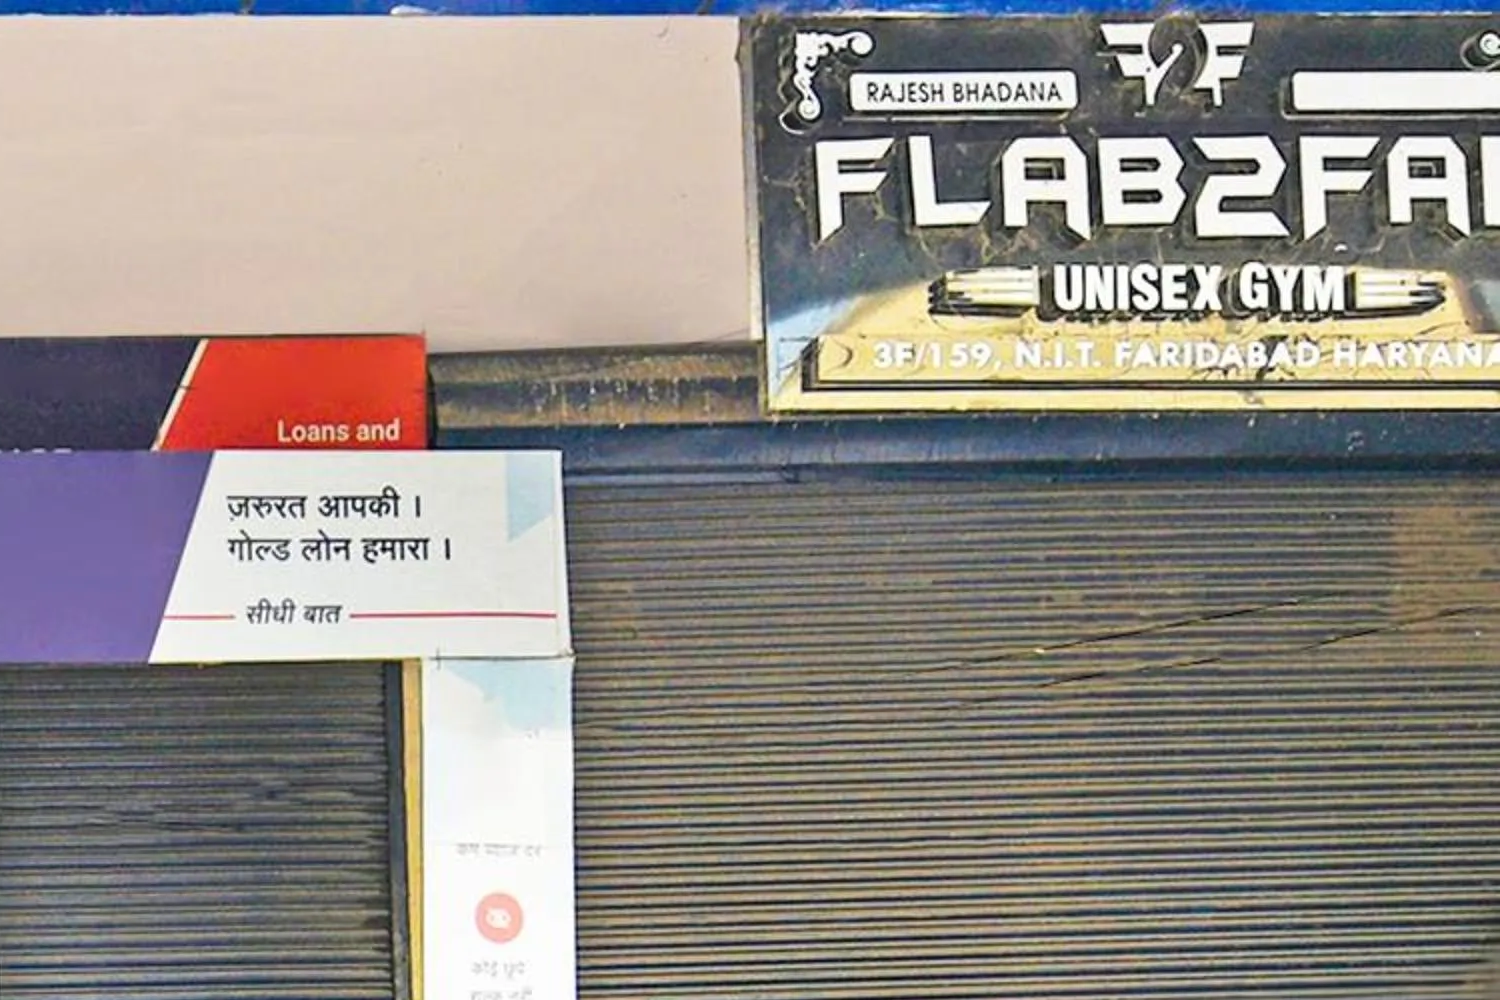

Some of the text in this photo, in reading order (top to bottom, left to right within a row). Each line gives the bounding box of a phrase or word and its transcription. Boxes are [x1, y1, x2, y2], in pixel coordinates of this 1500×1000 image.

[867, 80, 1063, 103] RAJESH BHADANA
[814, 134, 1500, 241] FLAB2FA
[1055, 261, 1346, 313] UNISEX GYM
[873, 340, 1500, 373] 3F/159, N.I.T. FARIDABAD HARYANA
[276, 418, 400, 443] Loans and
[317, 485, 401, 518] आपकी
[227, 530, 292, 562] गोल्ड
[300, 530, 353, 562] लोन
[361, 537, 430, 564] हमारा
[246, 597, 343, 624] सीधी बात
